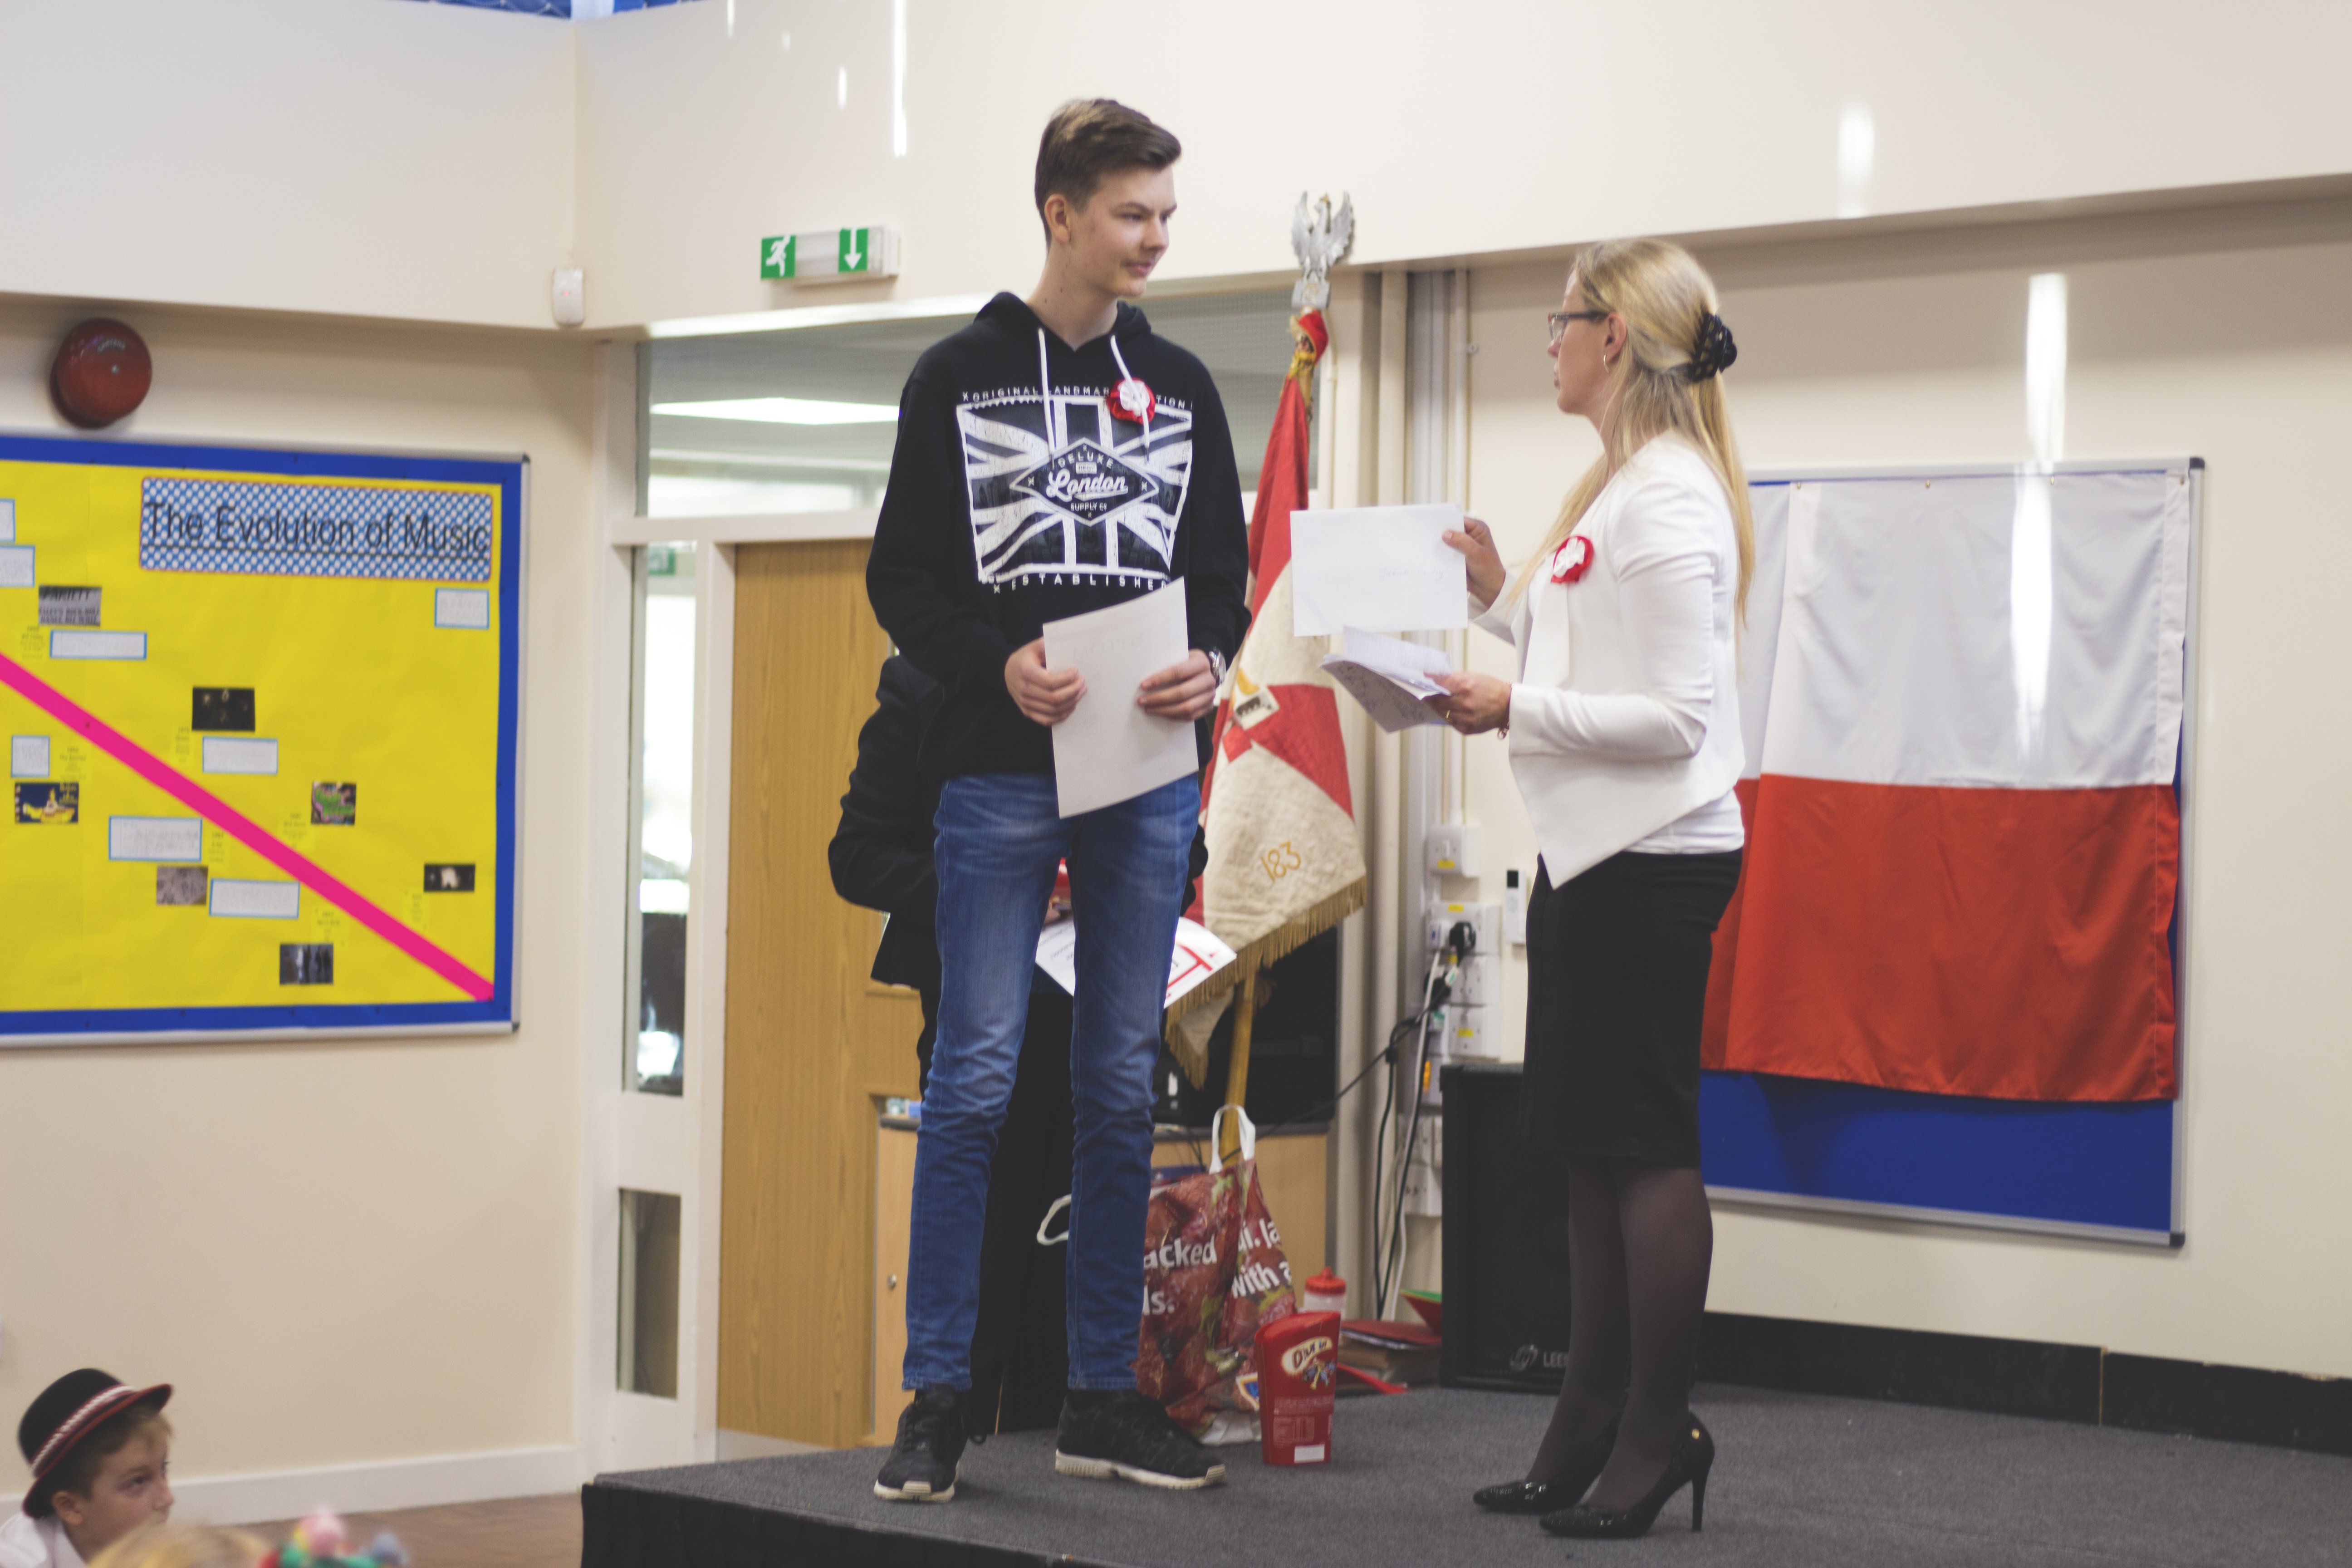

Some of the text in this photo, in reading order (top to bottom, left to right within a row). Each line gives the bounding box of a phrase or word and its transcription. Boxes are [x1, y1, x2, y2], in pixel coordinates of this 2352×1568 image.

[973, 386, 1039, 403] ORIGINAL
[1058, 451, 1114, 469] DELUXE
[1046, 468, 1128, 503] London
[1070, 502, 1098, 512] SUPPLY
[146, 502, 489, 552] The Evolution of Music
[1012, 573, 1167, 591] ESTABLISHED
[1259, 839, 1301, 883] 183
[1143, 1233, 1218, 1270] acked
[1231, 1261, 1280, 1299] with
[1142, 1284, 1176, 1316] ls.
